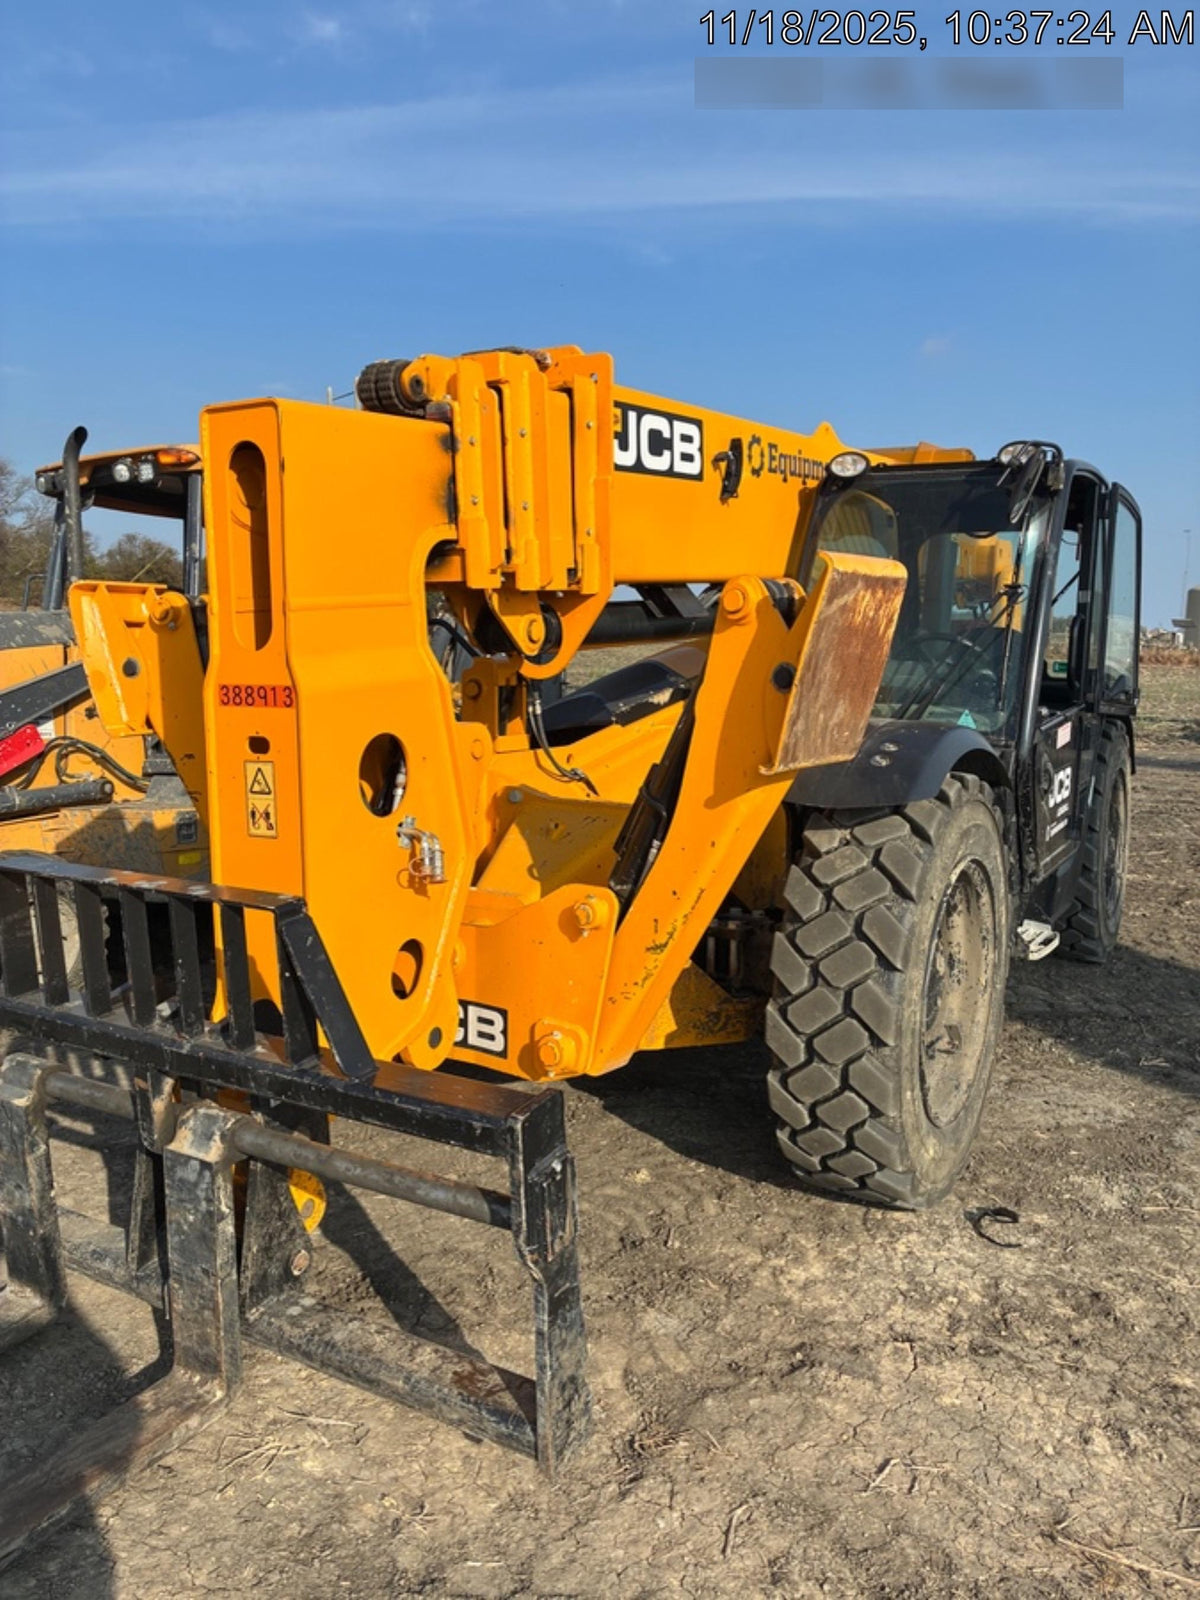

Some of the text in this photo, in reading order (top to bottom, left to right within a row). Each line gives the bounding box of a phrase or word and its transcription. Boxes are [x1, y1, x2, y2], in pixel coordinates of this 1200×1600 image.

[613, 410, 702, 475] JCB
[768, 442, 824, 486] Equipm
[220, 684, 294, 708] 388913
